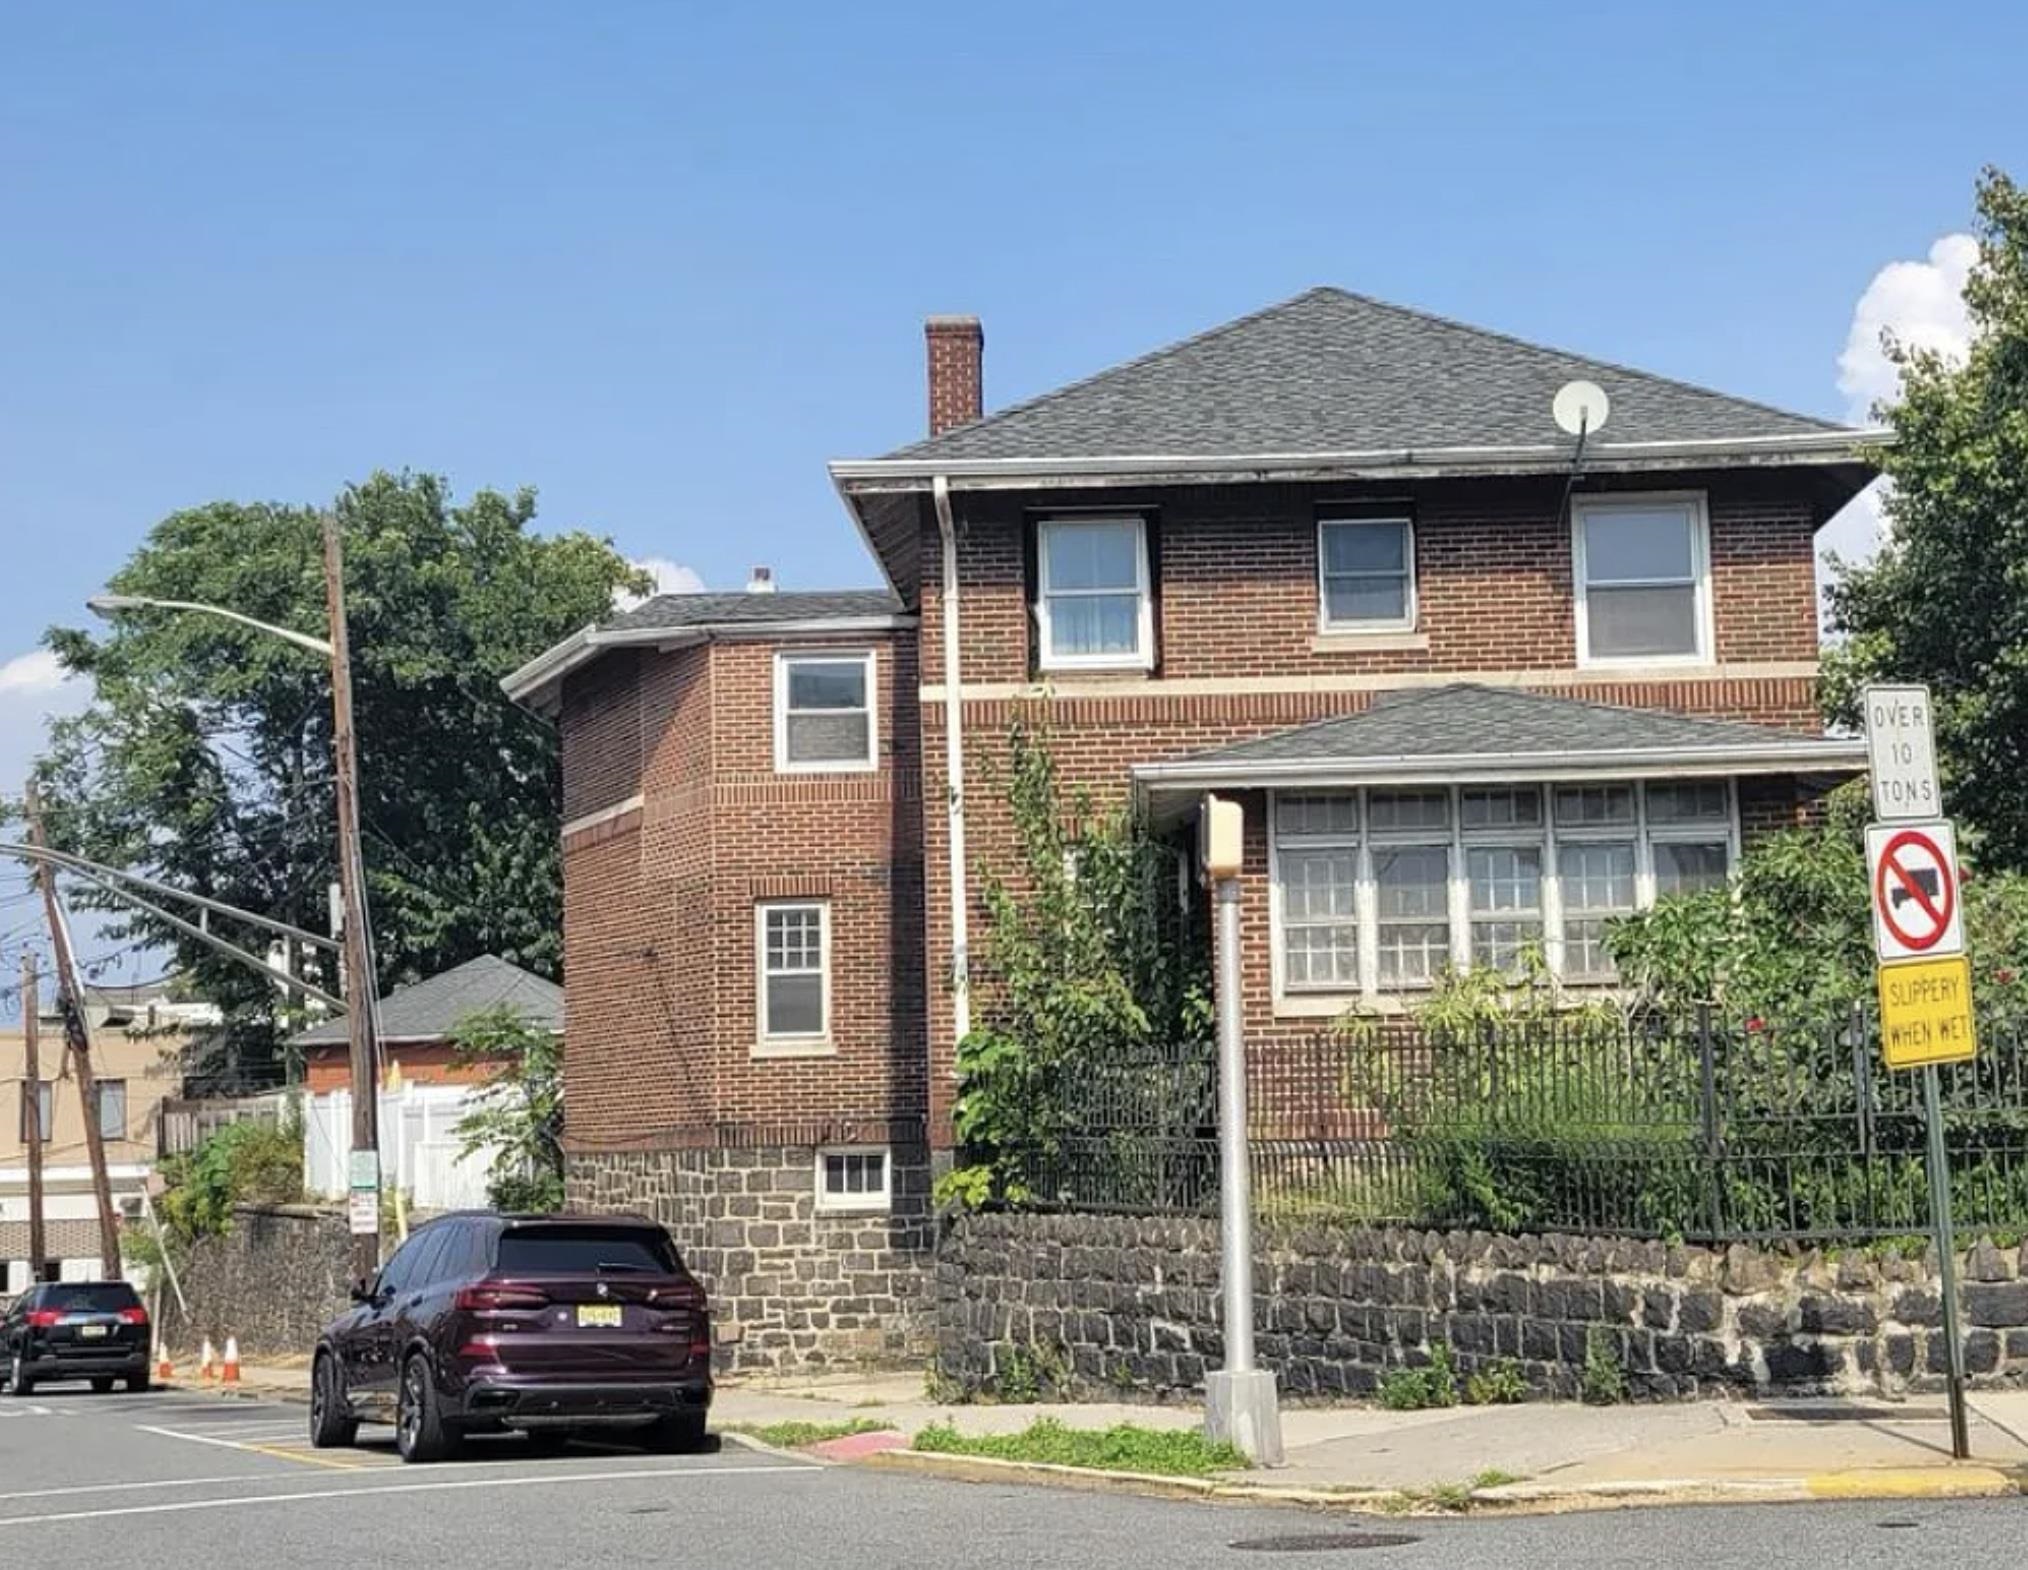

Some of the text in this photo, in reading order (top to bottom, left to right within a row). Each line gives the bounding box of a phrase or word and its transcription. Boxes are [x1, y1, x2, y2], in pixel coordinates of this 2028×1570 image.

[1874, 705, 1925, 728] OVER
[1891, 742, 1913, 765] 10
[1880, 779, 1932, 802] TONS
[1889, 975, 1960, 1007] SLIPPERY
[1890, 1014, 1968, 1049] WHEN WET
